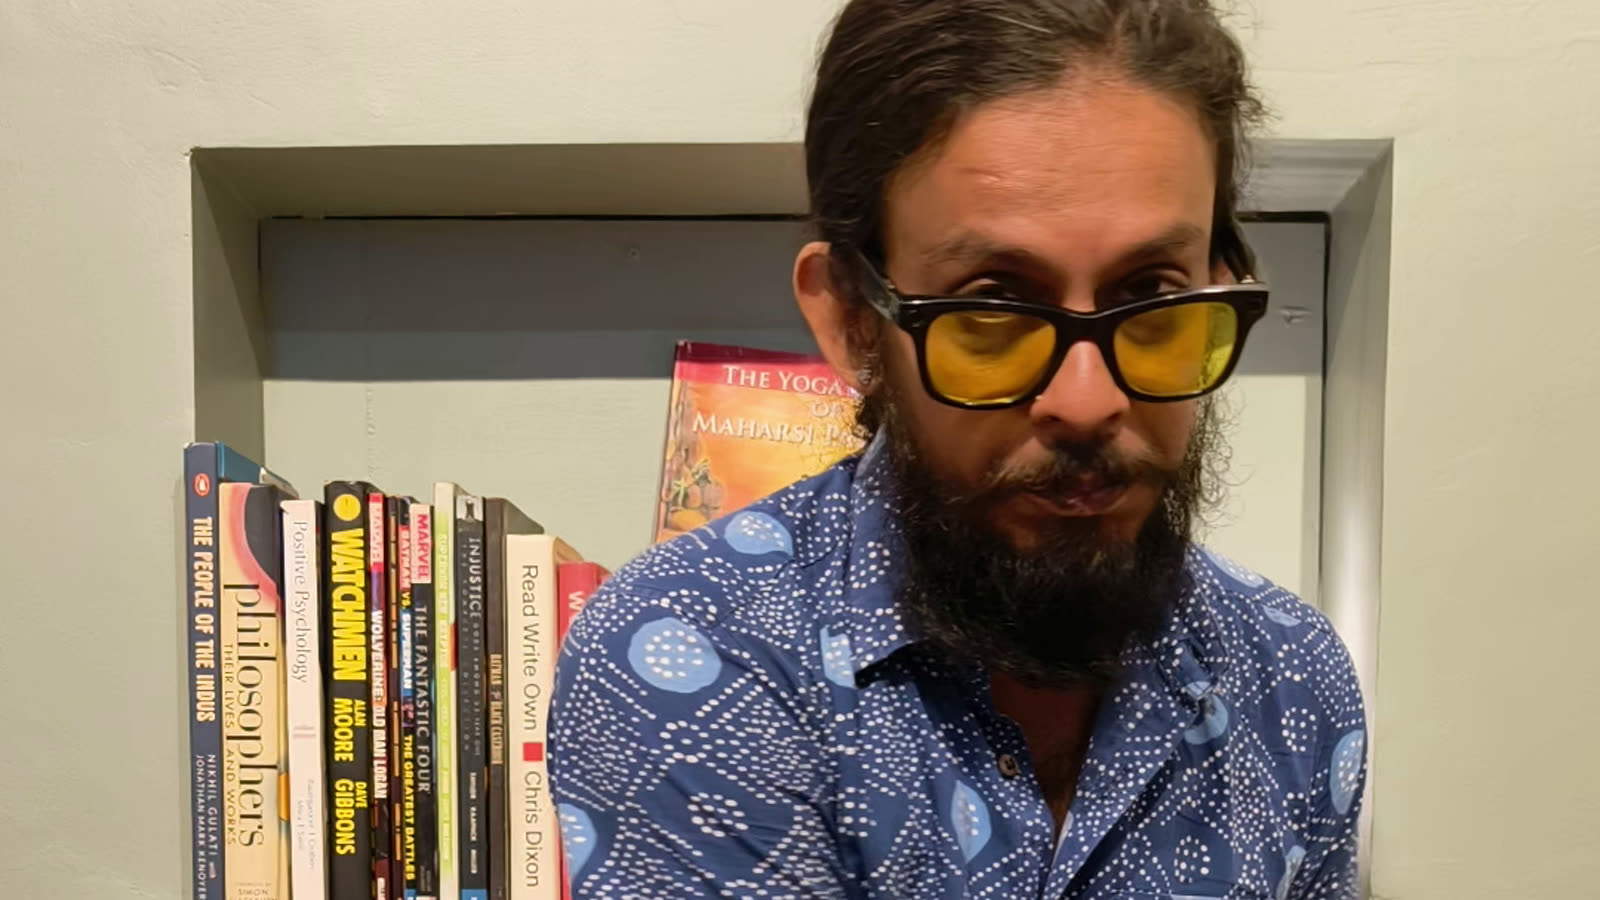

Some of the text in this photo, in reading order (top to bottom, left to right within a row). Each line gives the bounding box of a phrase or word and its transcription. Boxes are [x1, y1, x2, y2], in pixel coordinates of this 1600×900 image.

[724, 365, 843, 395] THE YOGA
[812, 401, 841, 417] OF
[400, 530, 410, 588] BATMAN
[417, 513, 429, 579] MARVEL
[469, 537, 481, 618] INJUSTICE
[193, 517, 216, 722] THE PEOPLE OF THE INDUS
[291, 521, 312, 684] Positive Psychology
[331, 528, 367, 681] WATCHMEN
[402, 613, 413, 689] SUPERMAN
[223, 584, 278, 847] philosophers
[334, 698, 354, 762] MOORE
[354, 699, 367, 727] ALAN
[373, 705, 386, 728] OLD
[415, 606, 430, 793] THE FANTASTIC FOUR
[522, 565, 542, 887] Read Write Own Chris Dixon
[207, 754, 217, 801] NIKHIL
[224, 644, 236, 845] THEIR LIVES AND WORKS
[374, 729, 387, 758] MAN
[355, 781, 368, 808] DAVE
[374, 760, 388, 799] LOGAN
[404, 735, 415, 880] THE GREATEST BATTLES
[196, 754, 207, 900] JONATHAN MARK KENOYER
[208, 807, 218, 856] GULATI
[335, 778, 356, 855] GIBBONS
